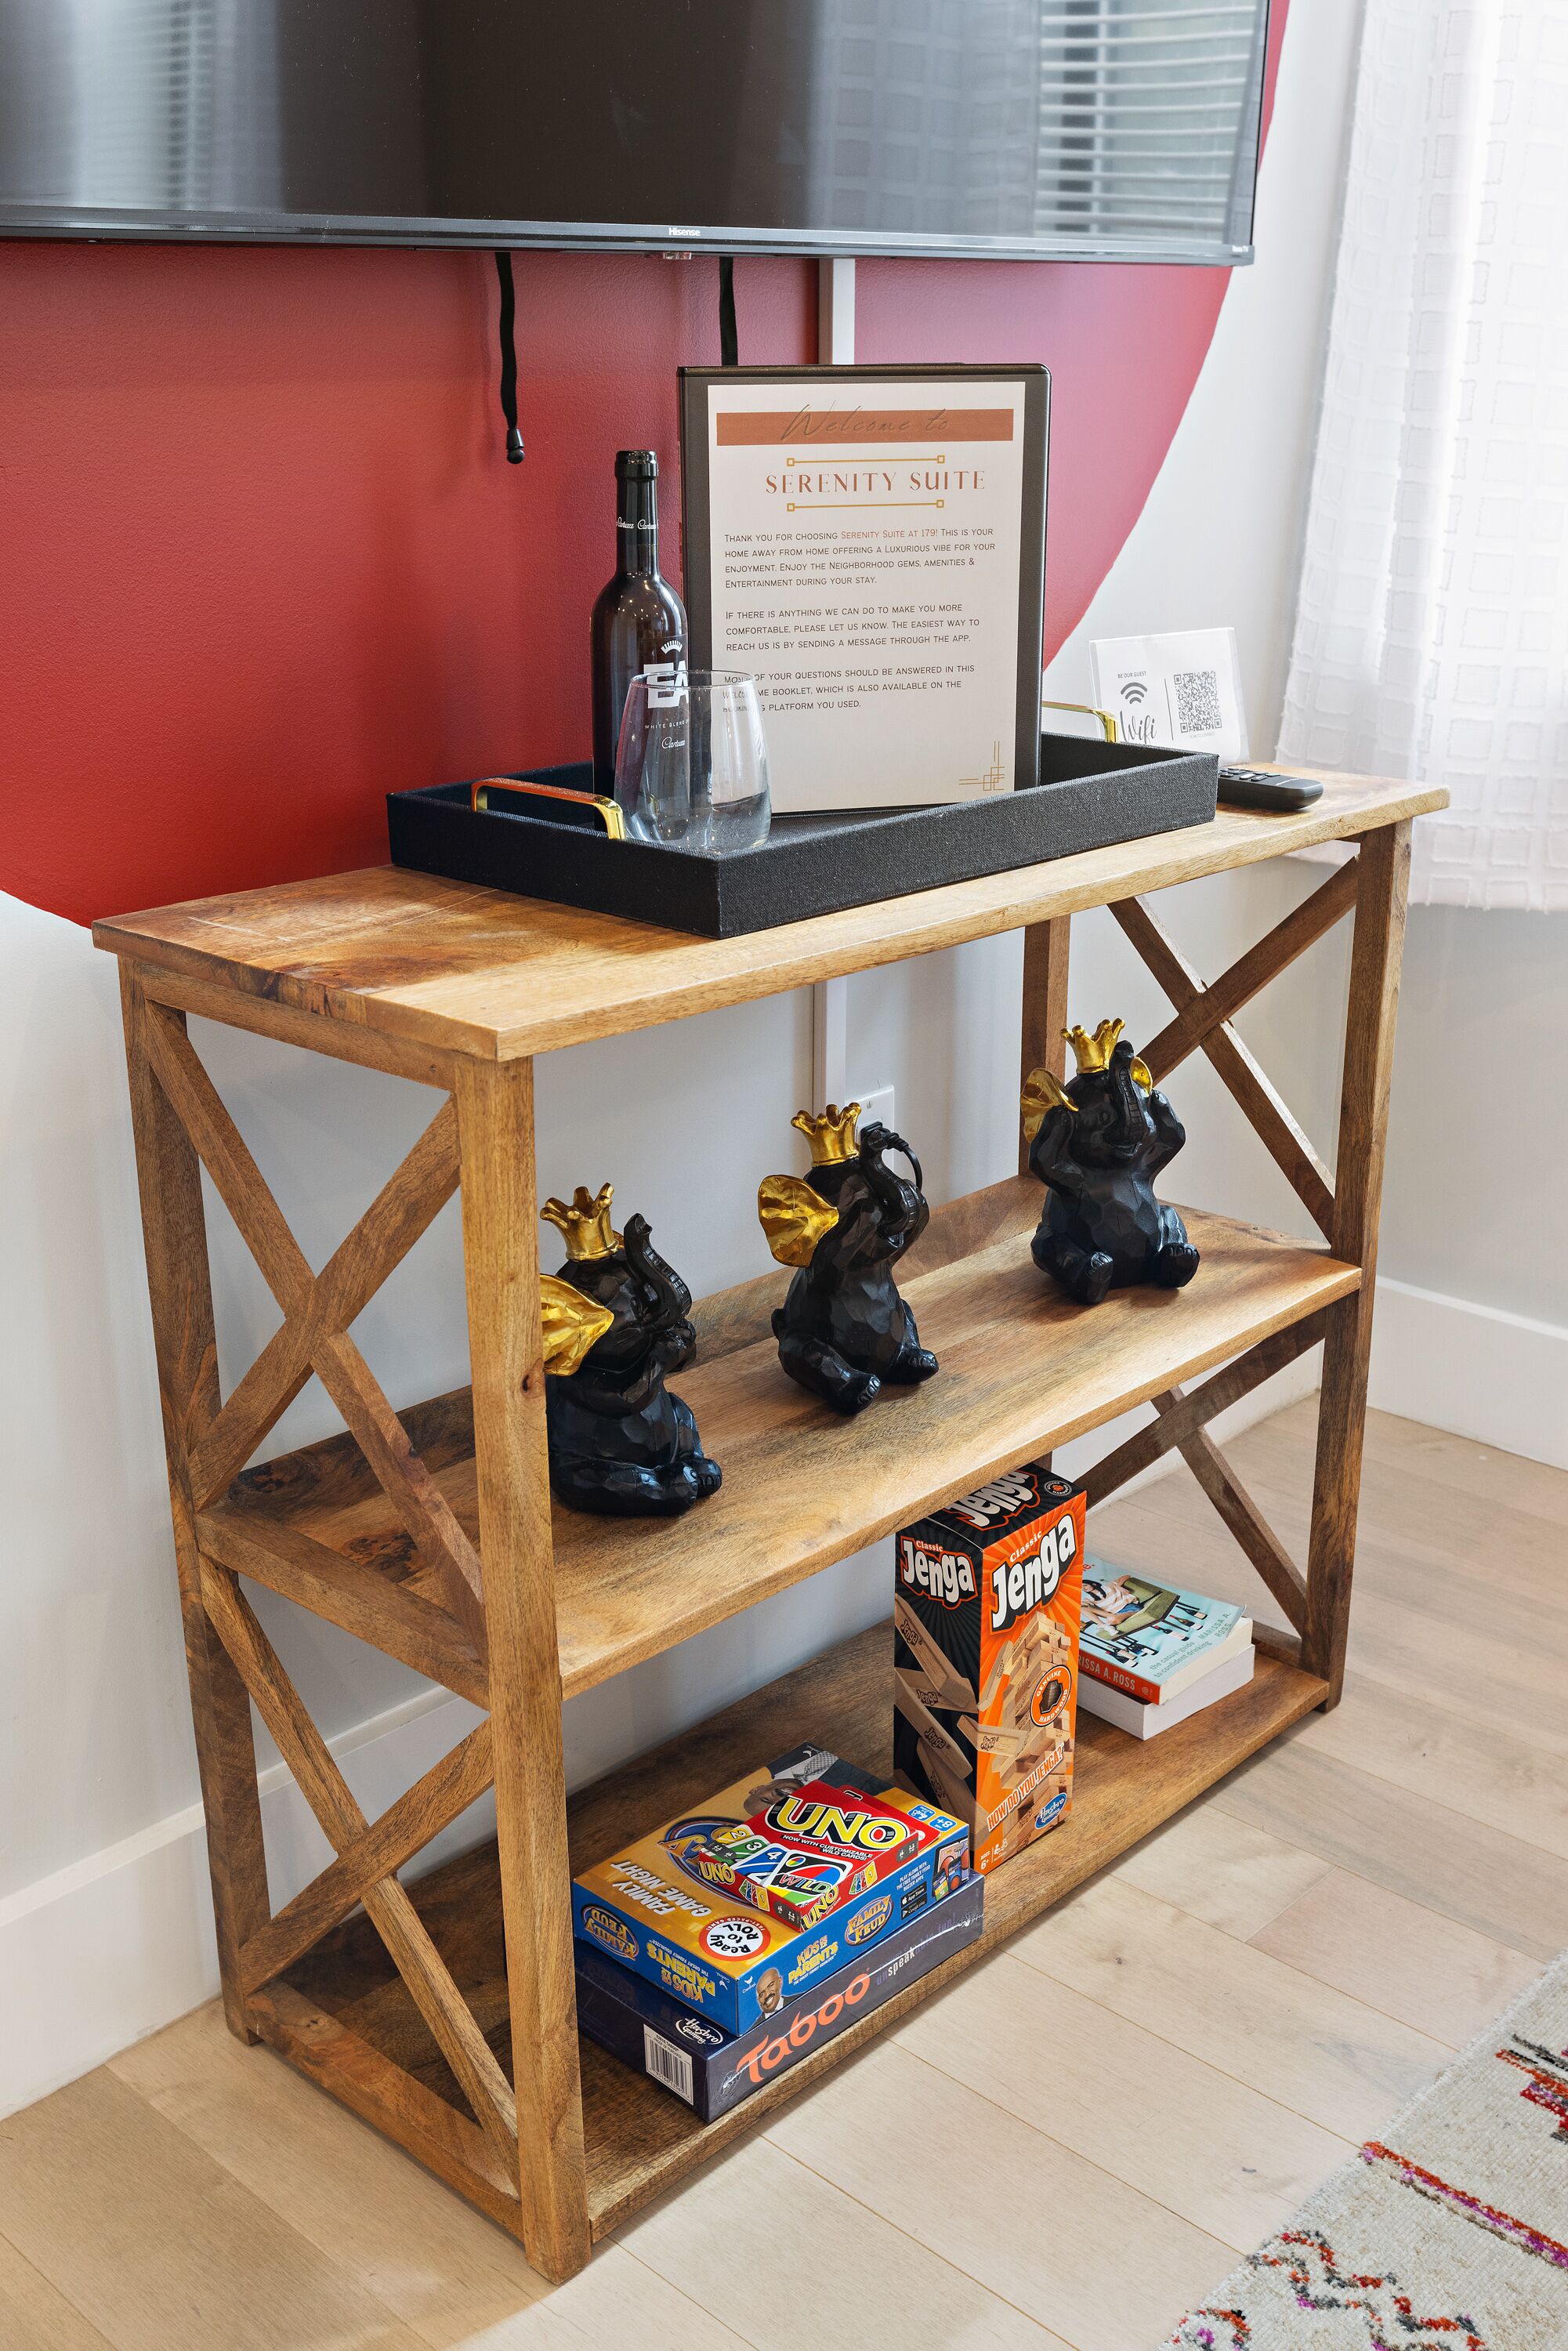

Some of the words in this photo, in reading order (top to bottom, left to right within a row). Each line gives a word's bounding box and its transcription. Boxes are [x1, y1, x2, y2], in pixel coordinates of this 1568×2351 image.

[668, 226, 701, 237] Hisense
[780, 400, 909, 440] Welcome
[925, 408, 948, 431] to
[766, 473, 897, 494] SERENITY
[910, 471, 985, 491] SUITE
[724, 534, 753, 543] THANK
[755, 534, 773, 542] YOU
[775, 533, 793, 542] FOR
[795, 532, 838, 541] CHOOSING
[841, 531, 880, 539] SERENITY
[882, 530, 906, 538] SUITE
[922, 528, 938, 538] 179!
[940, 528, 958, 537] THIS
[725, 549, 749, 558] HOME
[751, 549, 777, 557] AWAY
[779, 548, 802, 556] FROM
[806, 547, 830, 556] HOME
[832, 546, 874, 555] OFFERING
[885, 545, 930, 553] LUXURIOUS
[954, 543, 971, 552] FOR
[725, 564, 777, 574] ENJOYMENT.
[780, 563, 808, 571] ENJOY
[829, 560, 895, 570] NEIGHBORHOOD
[924, 558, 966, 567] AMENITIES
[969, 557, 975, 566] &
[725, 578, 793, 589] ENTERTAINMENT
[795, 578, 827, 587] DURING
[829, 577, 853, 585] YOUR
[725, 610, 734, 620] IF
[736, 610, 765, 620] THERE
[767, 610, 776, 618] IS
[778, 608, 822, 618] ANYTHING
[862, 607, 875, 615] DO
[877, 606, 889, 614] TO
[892, 605, 915, 614] MAKE
[918, 604, 936, 613] YOU
[938, 603, 963, 612] MORE
[794, 624, 826, 633] PLEASE
[829, 623, 845, 632] LET
[861, 621, 889, 630] KNOW.
[891, 620, 908, 629] THE
[911, 620, 945, 629] EASIEST
[968, 618, 980, 627] TO
[726, 643, 755, 651] REACH
[758, 642, 770, 650] US
[773, 641, 780, 650] IS
[798, 639, 835, 649] SENDING
[847, 637, 887, 647] MESSAGE
[889, 636, 930, 645] THROUGH
[932, 635, 950, 643] THE
[952, 634, 972, 643] APP.
[754, 672, 766, 681] OF
[768, 672, 793, 680] YOUR
[795, 670, 842, 679] QUESTIONS
[845, 668, 879, 678] SHOULD
[896, 665, 943, 676] ANSWERED
[644, 660, 690, 708] EA
[815, 685, 844, 694] WHICH
[856, 683, 879, 692] ALSO
[882, 682, 928, 691] AVAILABLE
[769, 701, 814, 712] PLATFORM
[817, 701, 835, 709] YOU
[837, 700, 861, 708] USED.
[1119, 710, 1157, 744] Wifi
[915, 1540, 943, 1552] Classic
[1009, 1529, 1042, 1563] Classic
[903, 1540, 975, 1603] Jenga
[992, 1514, 1077, 1628] Jenga
[900, 1619, 919, 1645] Jenga
[1197, 1618, 1225, 1639] MARISSA
[1215, 1622, 1232, 1638] ROSS
[1150, 1661, 1161, 1670] the
[1161, 1650, 1180, 1663] casual
[1178, 1641, 1196, 1653] guide
[1161, 1654, 1187, 1673] confident
[1036, 1670, 1062, 1697] GENUINE
[1103, 1667, 1111, 1679] A.
[1113, 1671, 1135, 1690] ROSS
[916, 1689, 939, 1706] Jenga
[1039, 1689, 1068, 1722] HARDWOOD
[924, 1727, 946, 1750] Jenga
[987, 1802, 1007, 1831] HOW
[1007, 1789, 1019, 1812] DO
[1019, 1772, 1036, 1800] YOU
[1036, 1745, 1063, 1784] JENGA?
[1040, 1798, 1064, 1818] Hasbro
[732, 1830, 747, 1839] 2
[766, 1798, 909, 1851] UNO
[746, 1842, 762, 1851] 3
[766, 1850, 783, 1860] 4
[783, 1835, 799, 1844] NOW
[801, 1838, 820, 1848] WITH
[820, 1843, 874, 1858] CUSTOMIZABLE
[821, 1847, 837, 1857] WILD
[836, 1850, 867, 1861] CARDS!
[610, 1860, 666, 1890] NIGHT
[700, 1862, 736, 1885] UNO
[981, 1859, 990, 1870] 6+
[780, 1874, 831, 1893] WILD
[915, 1888, 925, 1897] Store
[612, 1881, 676, 1915] FAMILY
[657, 1887, 712, 1918] GAME
[802, 1885, 838, 1932] UNO
[846, 1894, 892, 1933] FAMILY
[590, 1909, 628, 1942] FEUD
[706, 1918, 725, 1932] GAME!
[722, 1923, 759, 1940] ROLL
[726, 1917, 766, 1932] FAST-PACED
[853, 1915, 888, 1943] FEUD
[585, 1917, 636, 1961] FAMILY
[711, 1934, 751, 1954] Ready
[726, 1933, 743, 1943] to
[672, 1951, 686, 1964] FAMILY
[796, 1937, 820, 1966] KIDS
[646, 1942, 715, 1997] PARENTS
[700, 1969, 709, 1977] THE
[788, 1941, 838, 1984] PARENTS
[672, 1974, 704, 2004] KIDS
[682, 2025, 706, 2045] Gaming
[685, 2017, 719, 2044] Hasbro
[736, 1972, 871, 2083] Taboo
